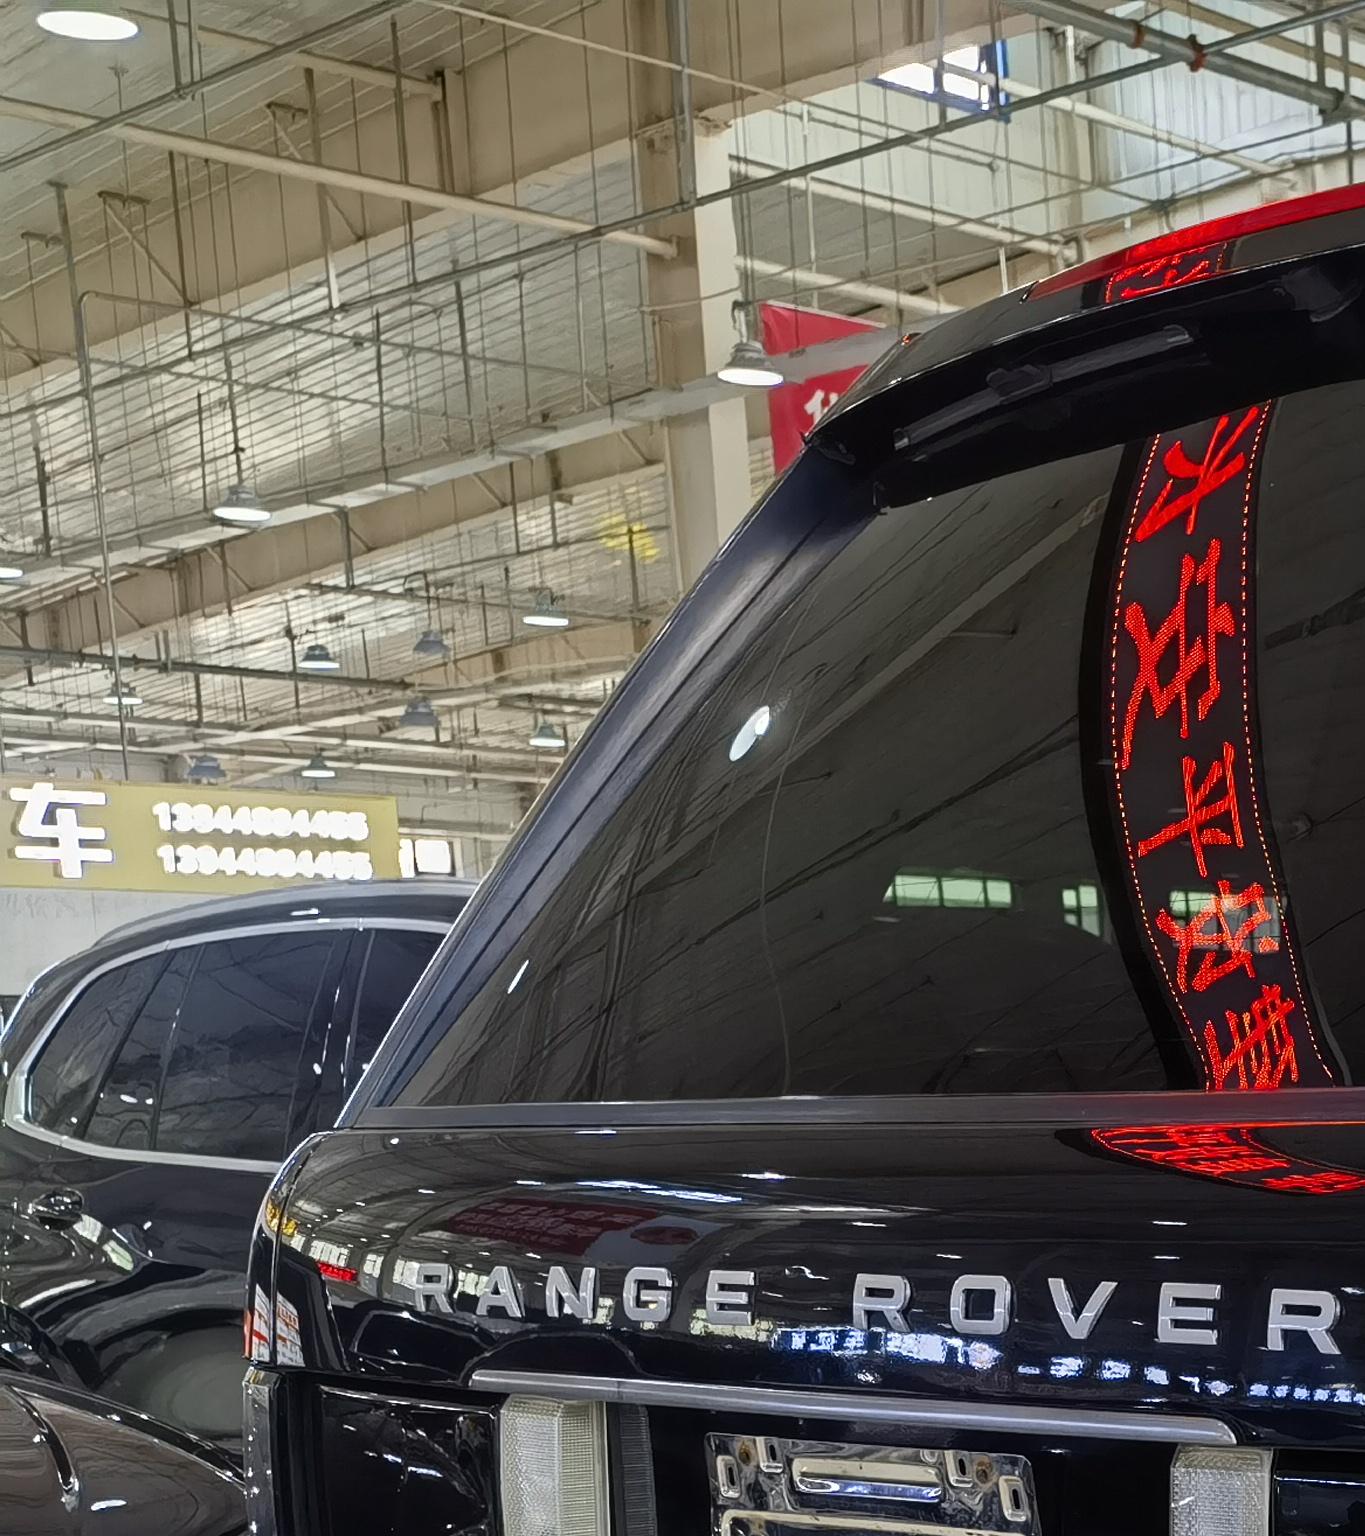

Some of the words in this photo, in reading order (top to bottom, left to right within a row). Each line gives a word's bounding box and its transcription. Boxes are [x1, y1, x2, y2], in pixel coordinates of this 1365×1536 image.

[9, 783, 113, 878] 车
[414, 1264, 760, 1327] RANGE
[852, 1272, 1343, 1356] ROVER
